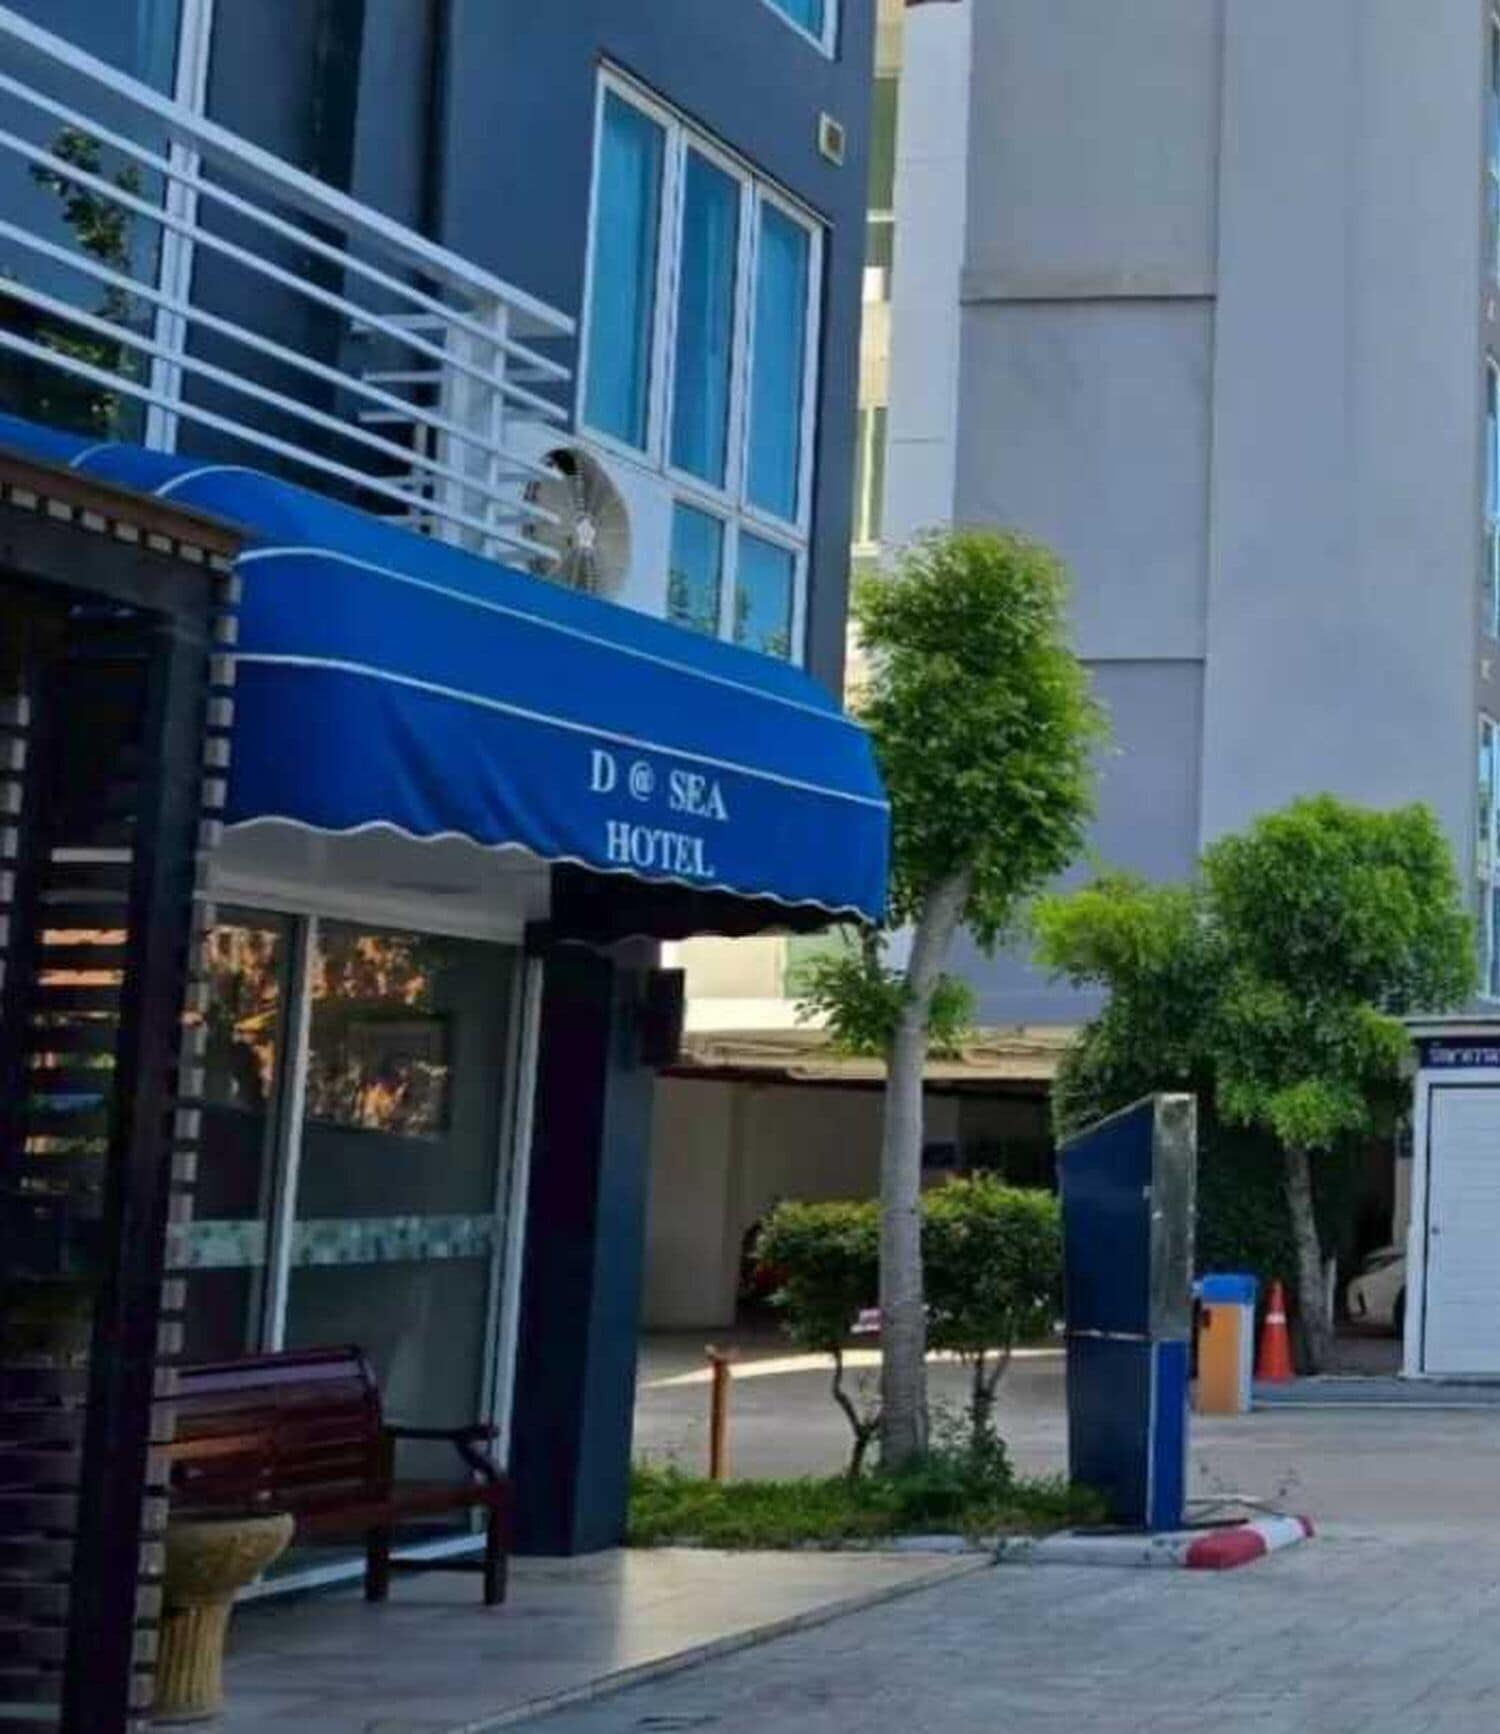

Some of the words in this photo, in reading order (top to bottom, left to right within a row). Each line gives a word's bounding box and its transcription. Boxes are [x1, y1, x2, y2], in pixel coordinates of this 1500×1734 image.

[590, 749, 616, 793] D
[628, 760, 654, 802] @
[669, 768, 729, 822] SEA
[606, 819, 716, 878] HOTEL
